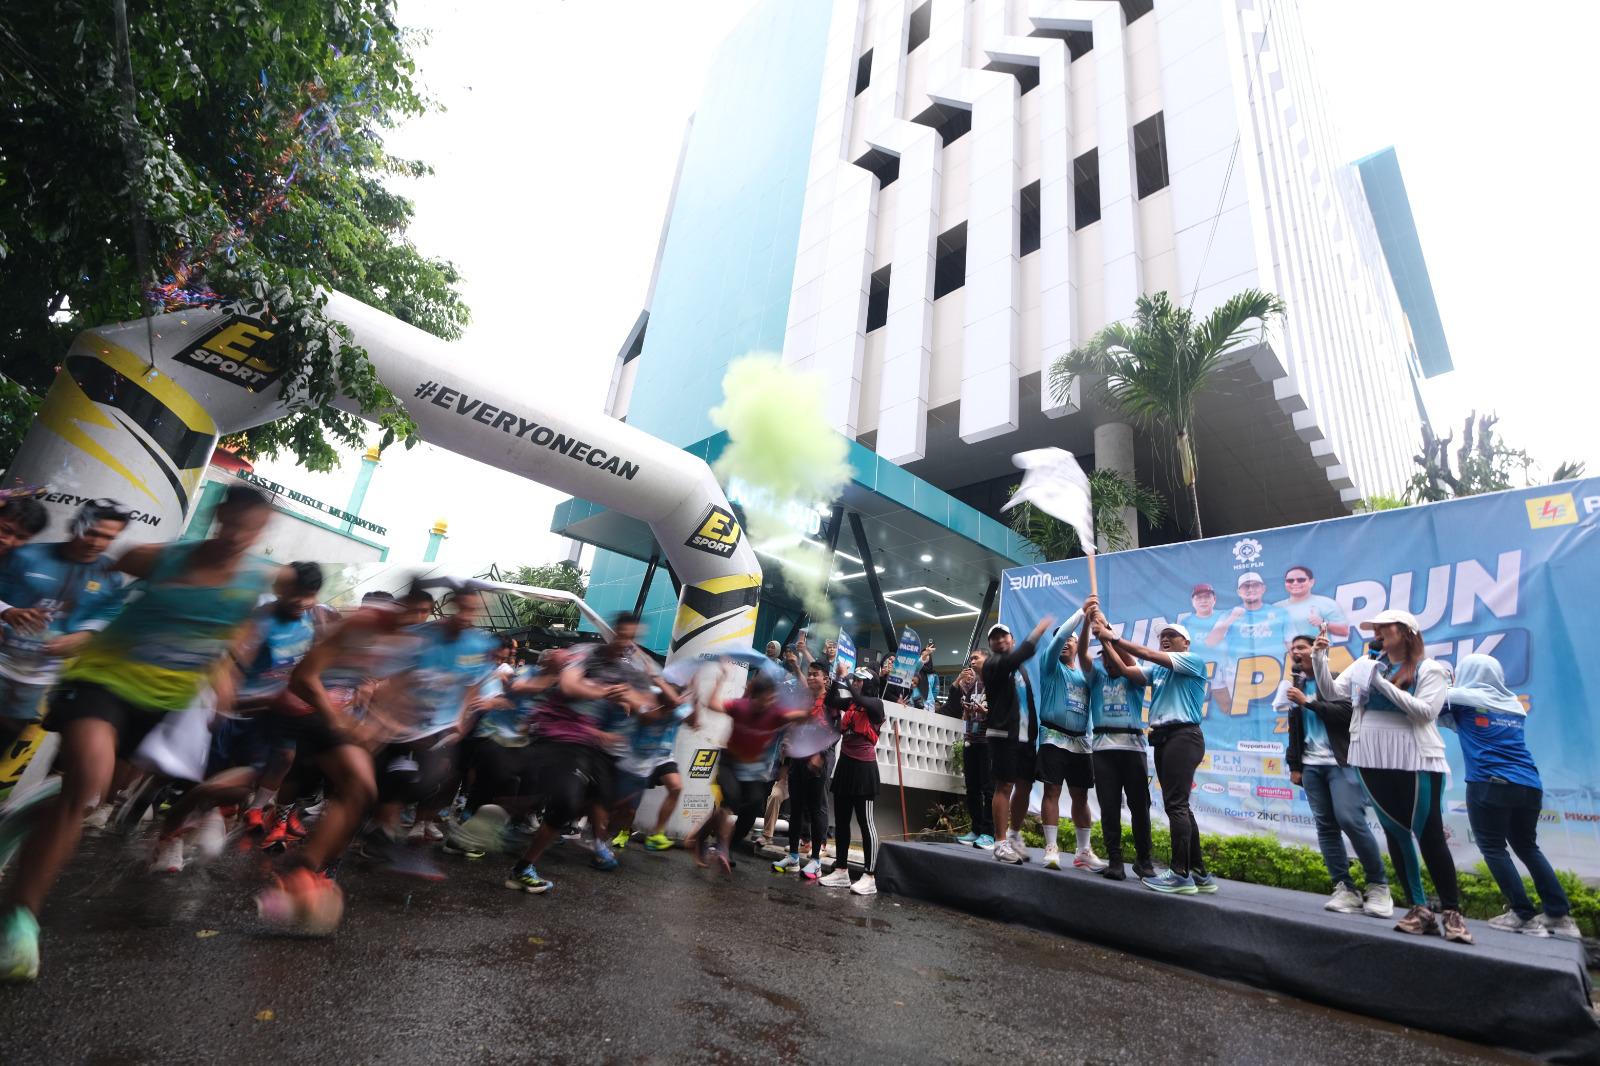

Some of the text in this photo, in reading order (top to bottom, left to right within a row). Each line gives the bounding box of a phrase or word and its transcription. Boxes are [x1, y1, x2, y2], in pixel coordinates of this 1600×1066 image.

[190, 349, 268, 383] SPORT
[413, 380, 640, 481] #EVERYONECAN
[237, 468, 285, 496] MASJID
[698, 511, 740, 544] EJ
[692, 536, 732, 553] SPORT
[1010, 573, 1052, 591] BUMN
[1332, 550, 1522, 645] RUN
[899, 643, 920, 652] PACER
[1240, 742, 1271, 750] Supported
[693, 751, 718, 767] EJ
[1213, 764, 1256, 774] Nusa Daya
